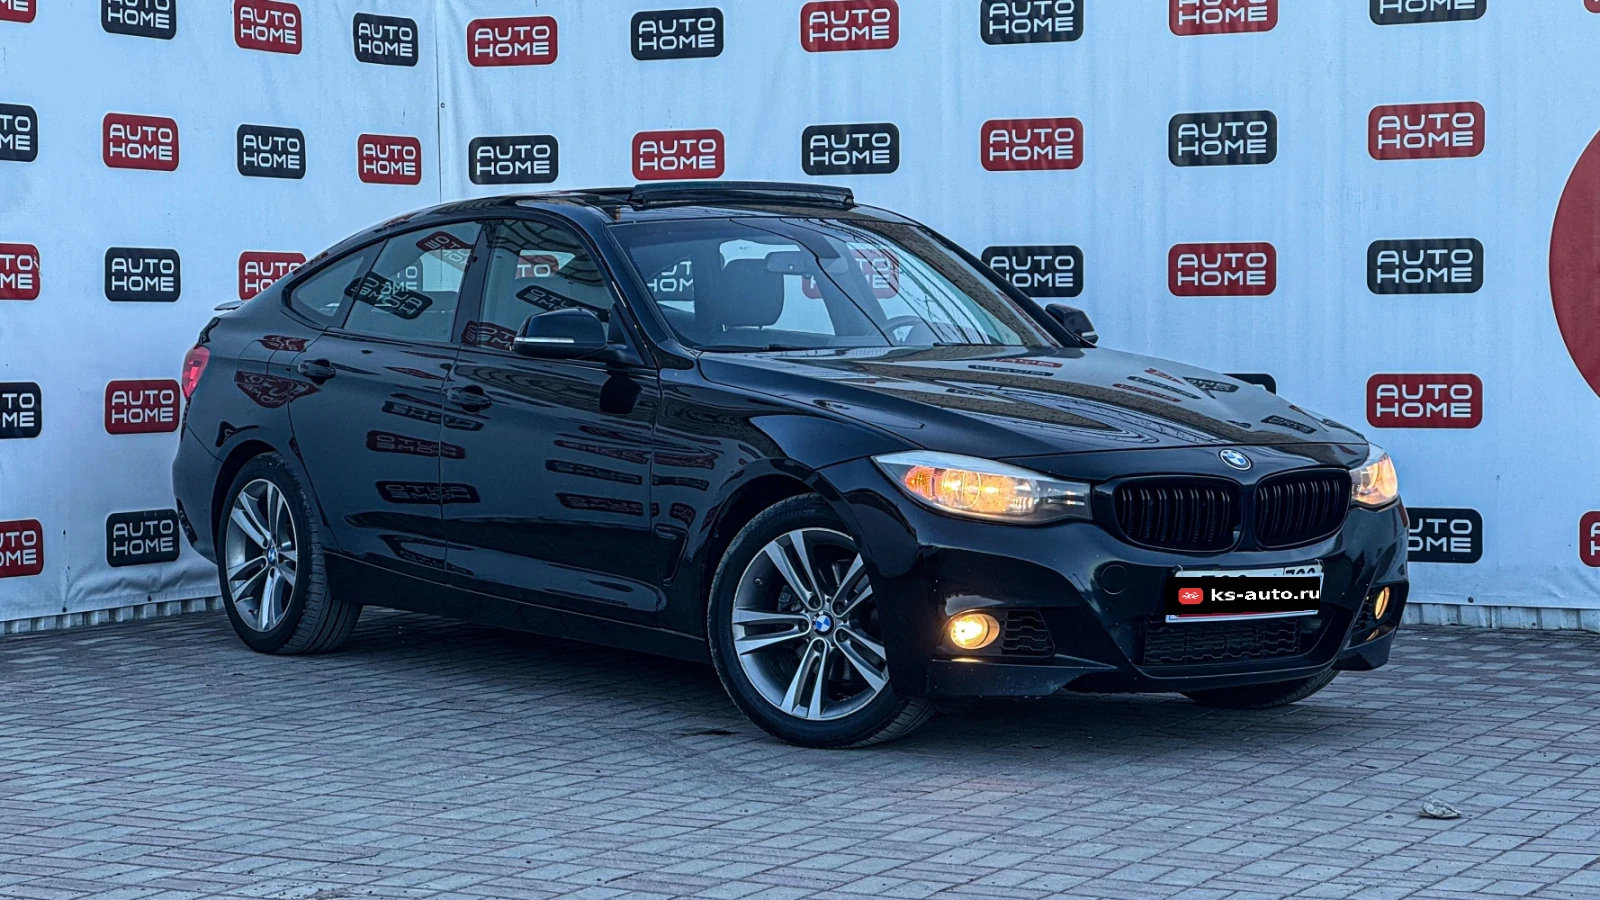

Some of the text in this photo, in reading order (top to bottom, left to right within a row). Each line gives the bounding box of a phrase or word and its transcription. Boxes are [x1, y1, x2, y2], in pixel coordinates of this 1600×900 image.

[240, 7, 297, 28] AUTO
[990, 0, 1075, 18] AUTO
[1179, 6, 1268, 26] HOME
[108, 7, 170, 30] HOME
[639, 17, 715, 35] AUTO
[809, 9, 891, 27] AUTO
[989, 17, 1074, 35] HOME
[241, 24, 297, 45] HOME
[358, 23, 413, 42] AUTO
[475, 26, 549, 42] AUTO
[809, 25, 890, 42] HOME
[359, 39, 413, 58] HOME
[475, 42, 550, 58] HOME
[639, 34, 715, 51] HOME
[0, 114, 32, 133] TO
[1178, 120, 1268, 139] AUTO
[1378, 112, 1475, 132] AUTO
[0, 133, 32, 151] ME
[110, 124, 173, 144] AUTO
[810, 133, 891, 150] AUTO
[990, 128, 1075, 145] AUTO
[1378, 131, 1474, 150] HOME
[110, 142, 173, 161] HOME
[243, 135, 301, 153] AUTO
[363, 144, 417, 160] AUTO
[640, 138, 717, 155] AUTO
[1178, 139, 1267, 157] HOME
[244, 152, 301, 170] HOME
[477, 145, 550, 161] AUTO
[810, 150, 890, 166] HOME
[990, 145, 1074, 162] HOME
[364, 160, 416, 176] HOME
[477, 161, 551, 176] HOME
[640, 155, 716, 171] HOME
[0, 254, 34, 271] TO
[989, 255, 1075, 271] AUTO
[1178, 252, 1268, 269] AUTO
[1377, 248, 1474, 266] AUTO
[111, 258, 175, 274] AUTO
[517, 264, 552, 280] TO
[0, 273, 34, 290] ME
[112, 276, 175, 292] HOME
[1006, 272, 1074, 288] OME
[1178, 270, 1266, 286] HOME
[1377, 267, 1473, 284] HOME
[111, 390, 175, 405] AUTO
[1377, 384, 1473, 400] AUTO
[3, 393, 35, 409] TO
[1377, 401, 1472, 417] HOME
[3, 411, 35, 428] ME
[112, 408, 174, 424] HOME
[114, 520, 174, 539] AUTO
[1409, 519, 1473, 534] UTO
[0, 531, 37, 549] TO
[114, 537, 174, 557] HOME
[1408, 537, 1472, 553] OME
[0, 549, 37, 567] ME
